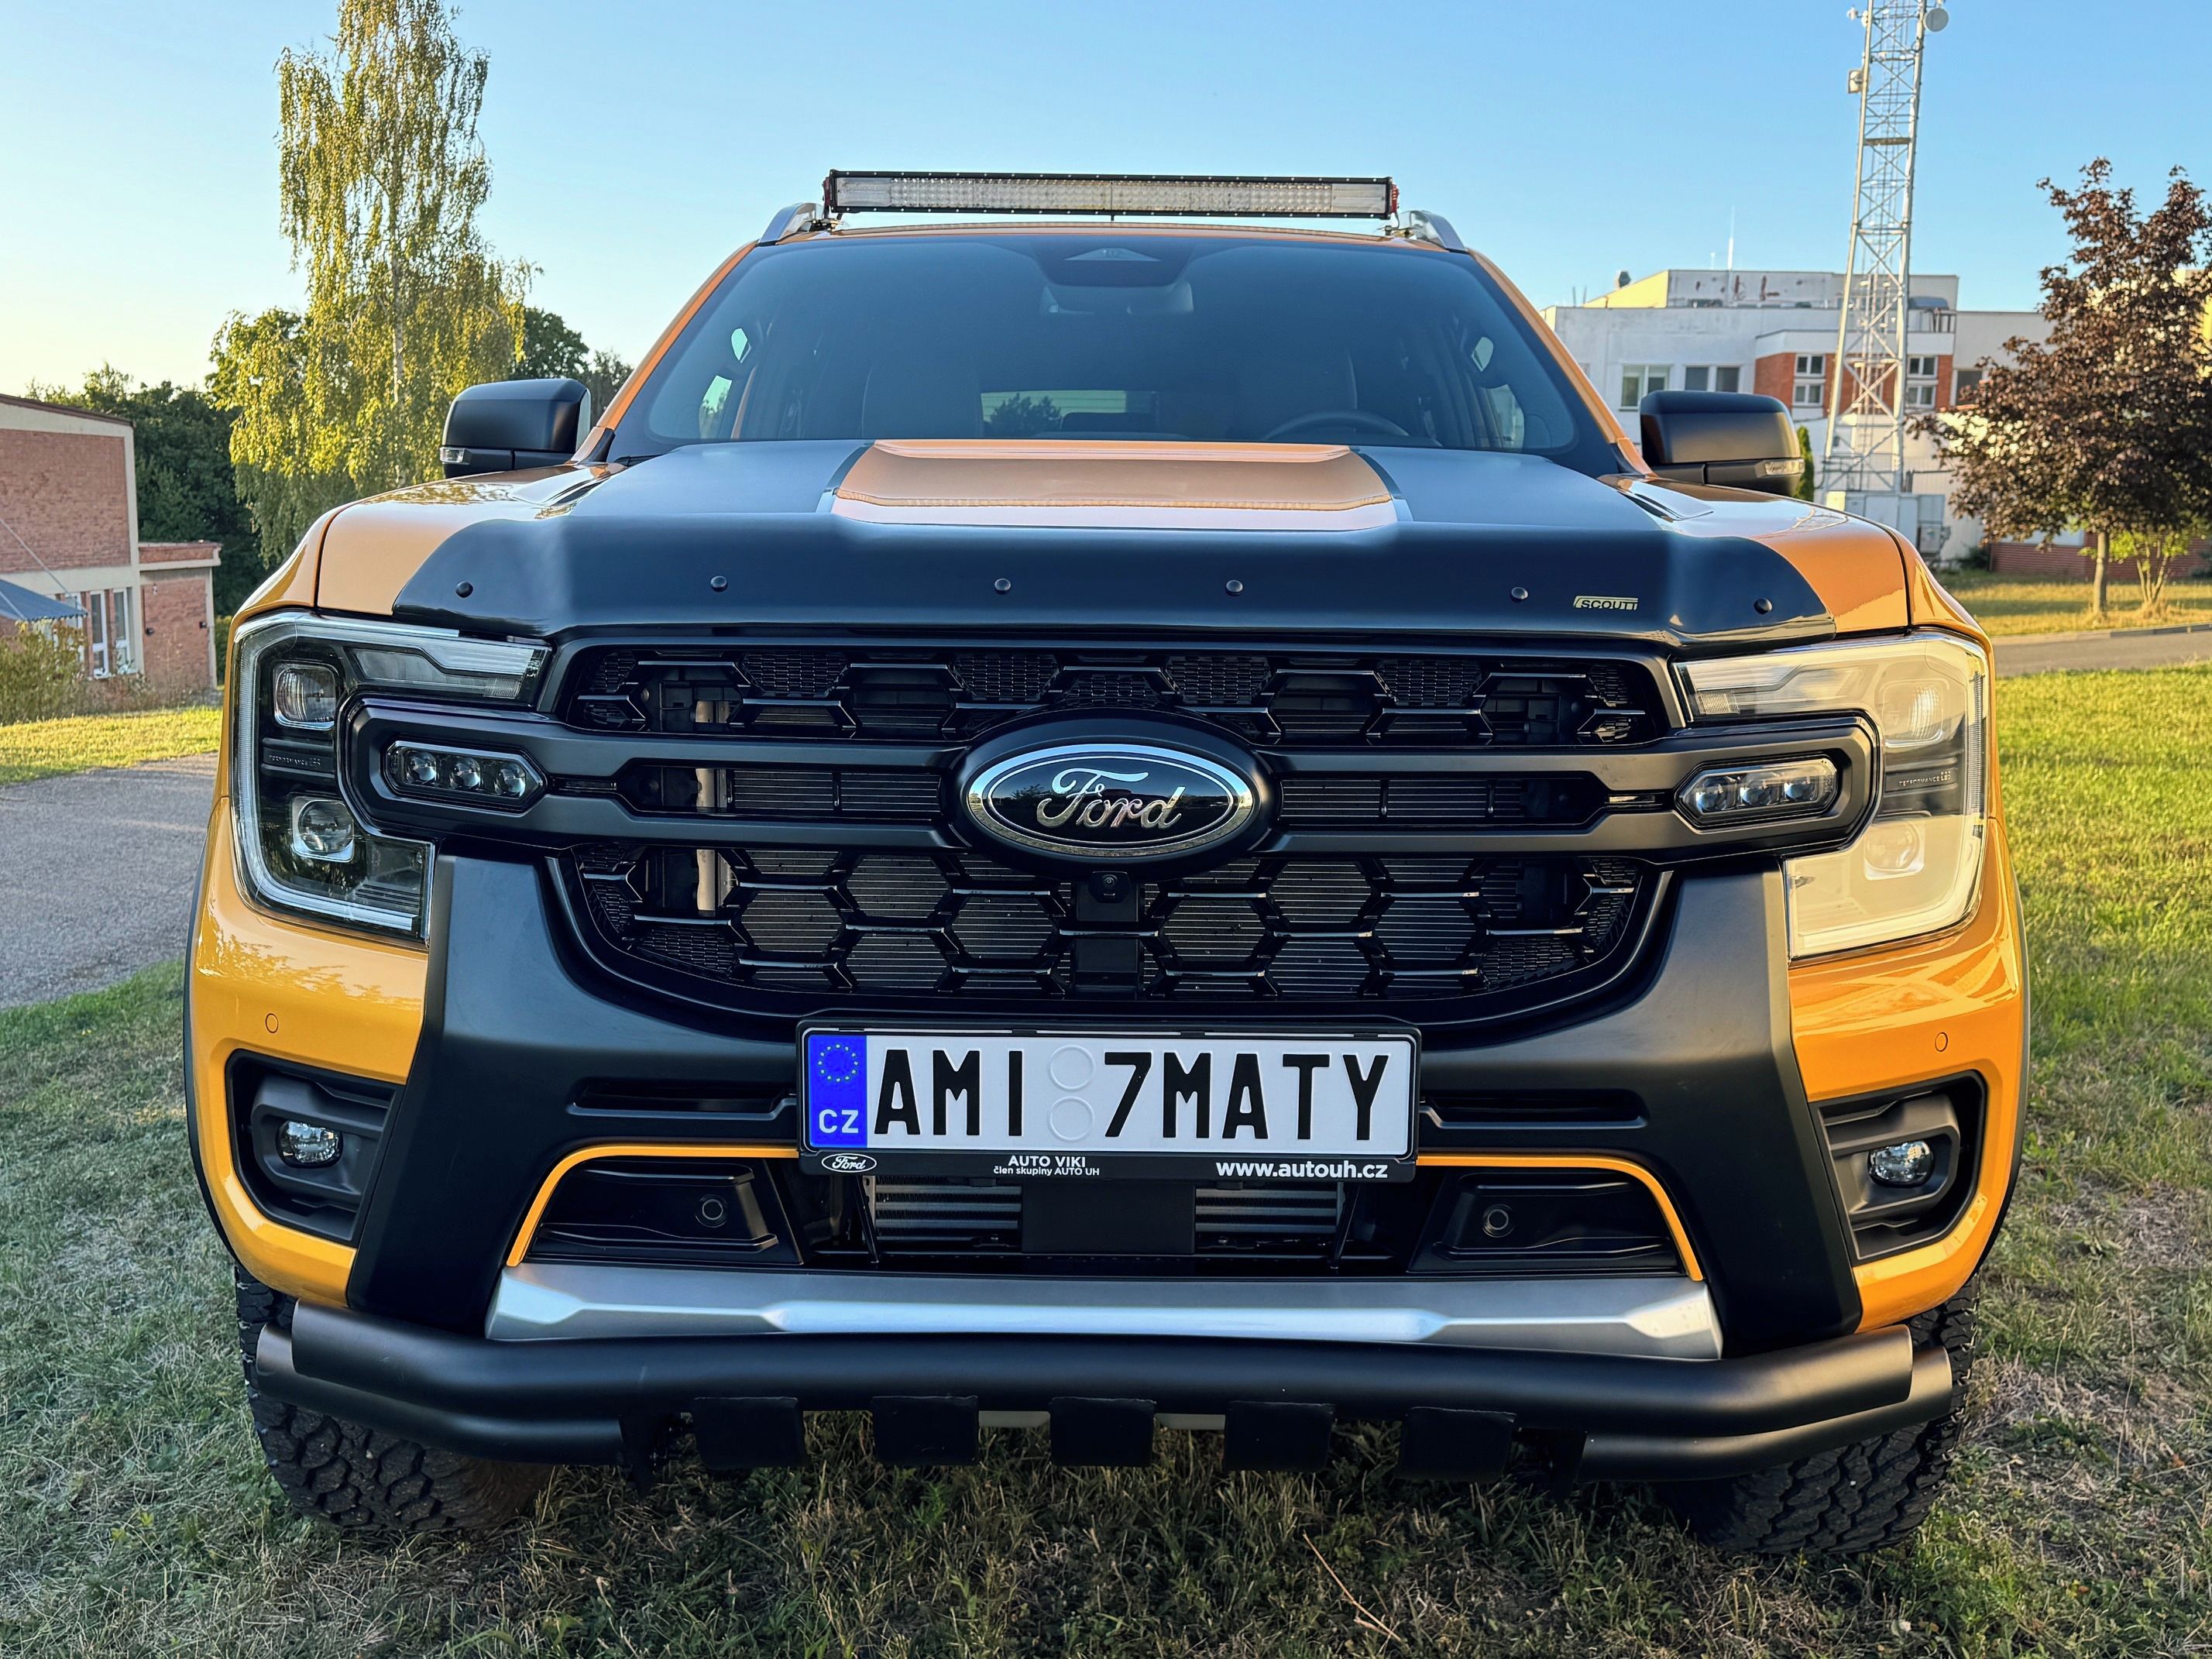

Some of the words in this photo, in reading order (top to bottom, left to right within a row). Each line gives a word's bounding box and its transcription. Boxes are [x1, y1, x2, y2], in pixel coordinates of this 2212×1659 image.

[1036, 768, 1187, 830] Ford
[874, 1049, 1023, 1136] AMI
[1104, 1050, 1389, 1140] 7MATY
[819, 1109, 859, 1134] CZ
[831, 1156, 867, 1170] Ford
[1008, 1155, 1051, 1167] AUTO
[1054, 1156, 1086, 1167] VIKI
[1215, 1160, 1389, 1179] www.autouh.cz
[993, 1166, 1014, 1174] člen
[1015, 1166, 1053, 1176] skupiny
[1054, 1167, 1083, 1176] AUTO
[1085, 1167, 1100, 1176] UH
